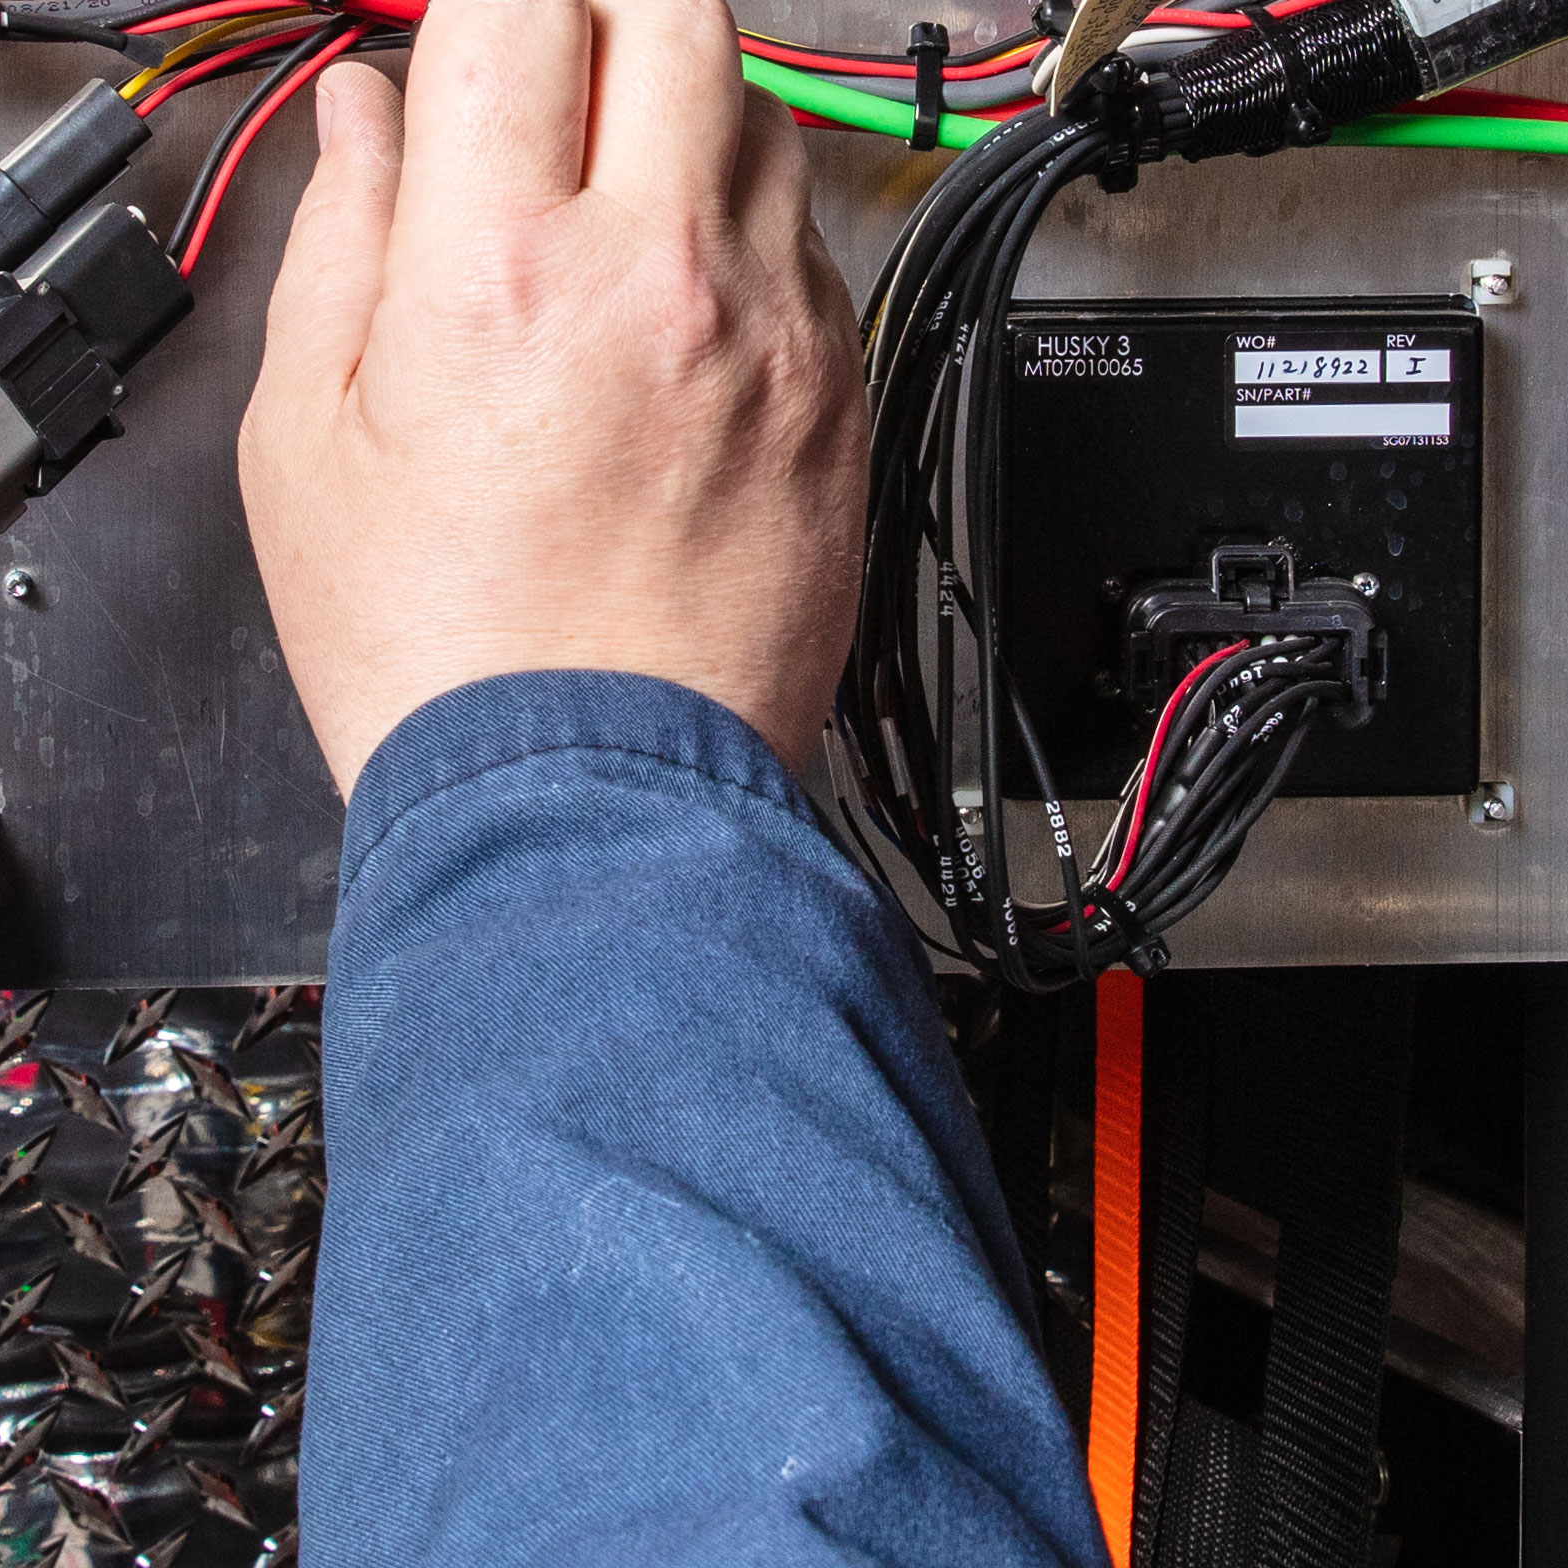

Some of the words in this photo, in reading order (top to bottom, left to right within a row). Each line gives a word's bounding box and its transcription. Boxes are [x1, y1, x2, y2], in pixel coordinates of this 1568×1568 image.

[1038, 335, 1110, 356] HUSKY
[1117, 335, 1130, 355] 3
[1236, 335, 1276, 349] WO#
[1386, 334, 1416, 348] REV
[1024, 358, 1143, 377] MT07010065
[1236, 388, 1312, 402] SN/PART#
[1382, 435, 1450, 447] SG07131153
[1045, 799, 1072, 859] 2882
